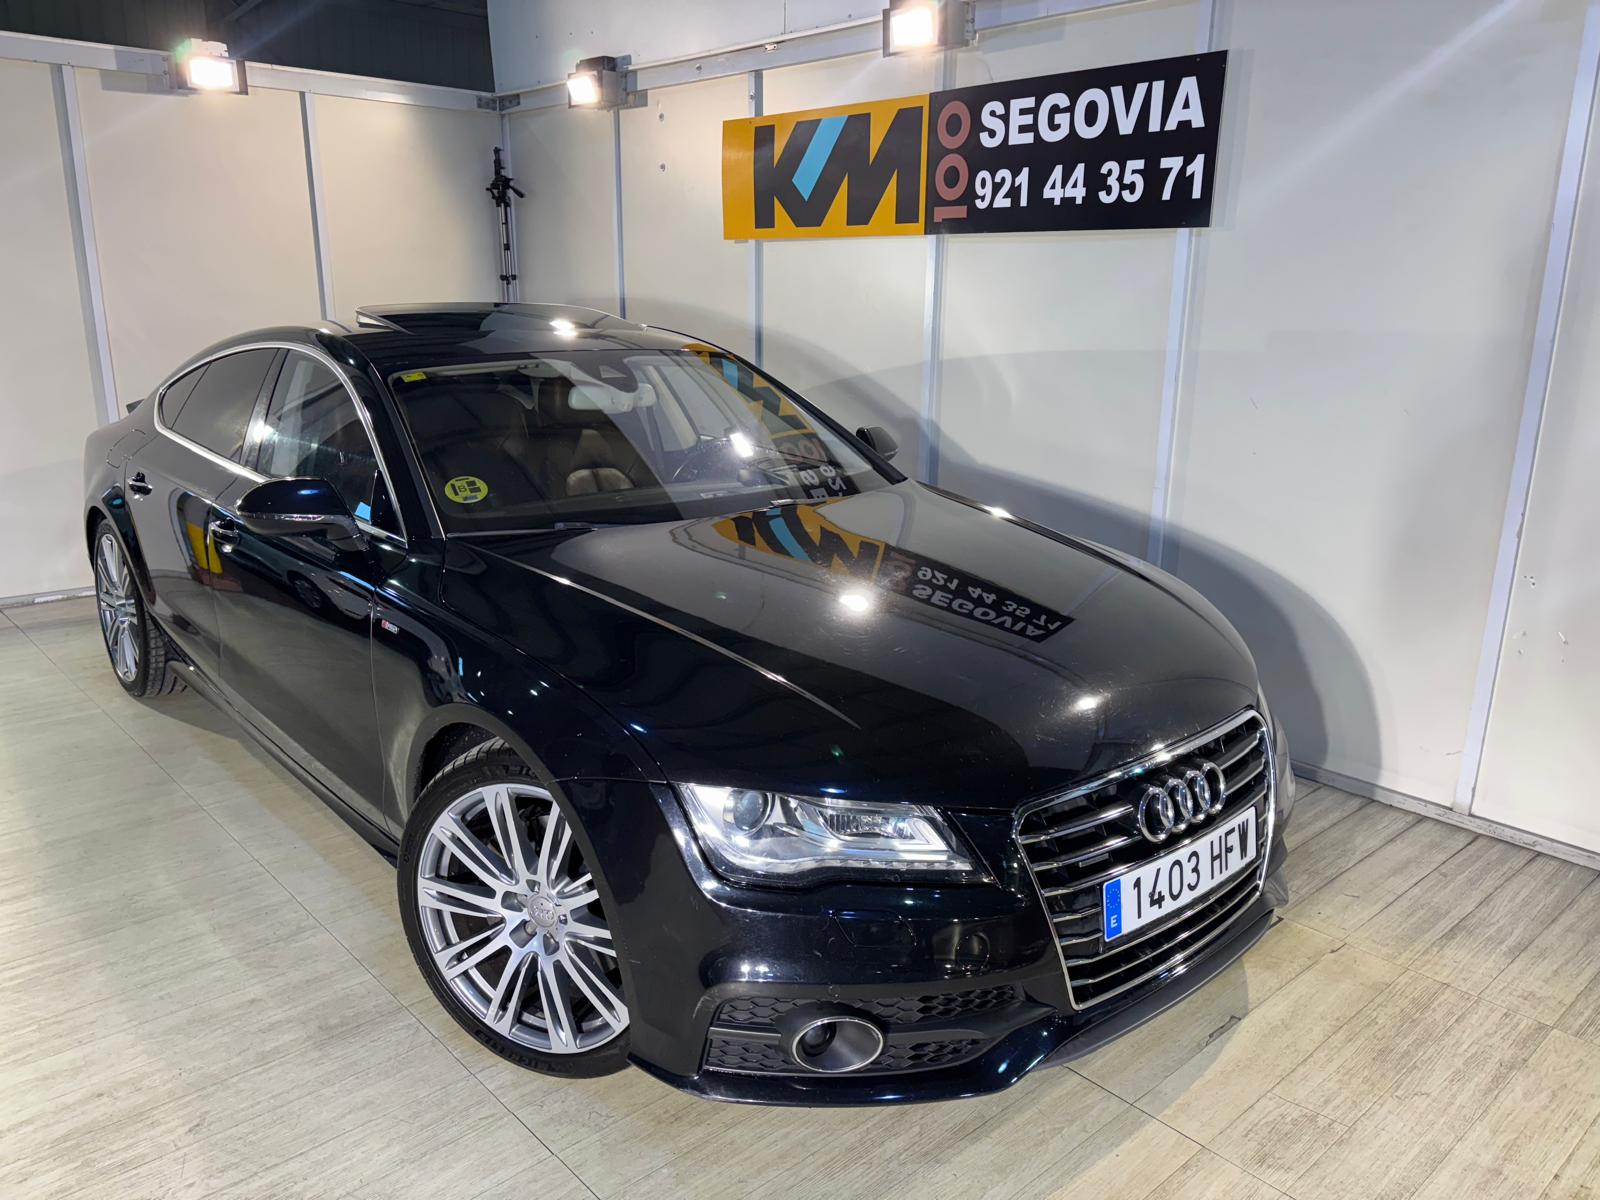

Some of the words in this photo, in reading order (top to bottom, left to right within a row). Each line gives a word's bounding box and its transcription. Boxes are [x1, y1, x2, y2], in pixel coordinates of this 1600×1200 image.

[979, 75, 1206, 149] SEGOVIA
[754, 105, 924, 230] KM
[933, 100, 972, 223] 100
[974, 166, 1031, 210] 921
[1042, 162, 1087, 206] 44
[1097, 158, 1146, 204] 35
[1158, 153, 1206, 201] 71
[1132, 850, 1201, 920] 1403
[1209, 818, 1249, 881] HFW
[1110, 914, 1118, 928] E
